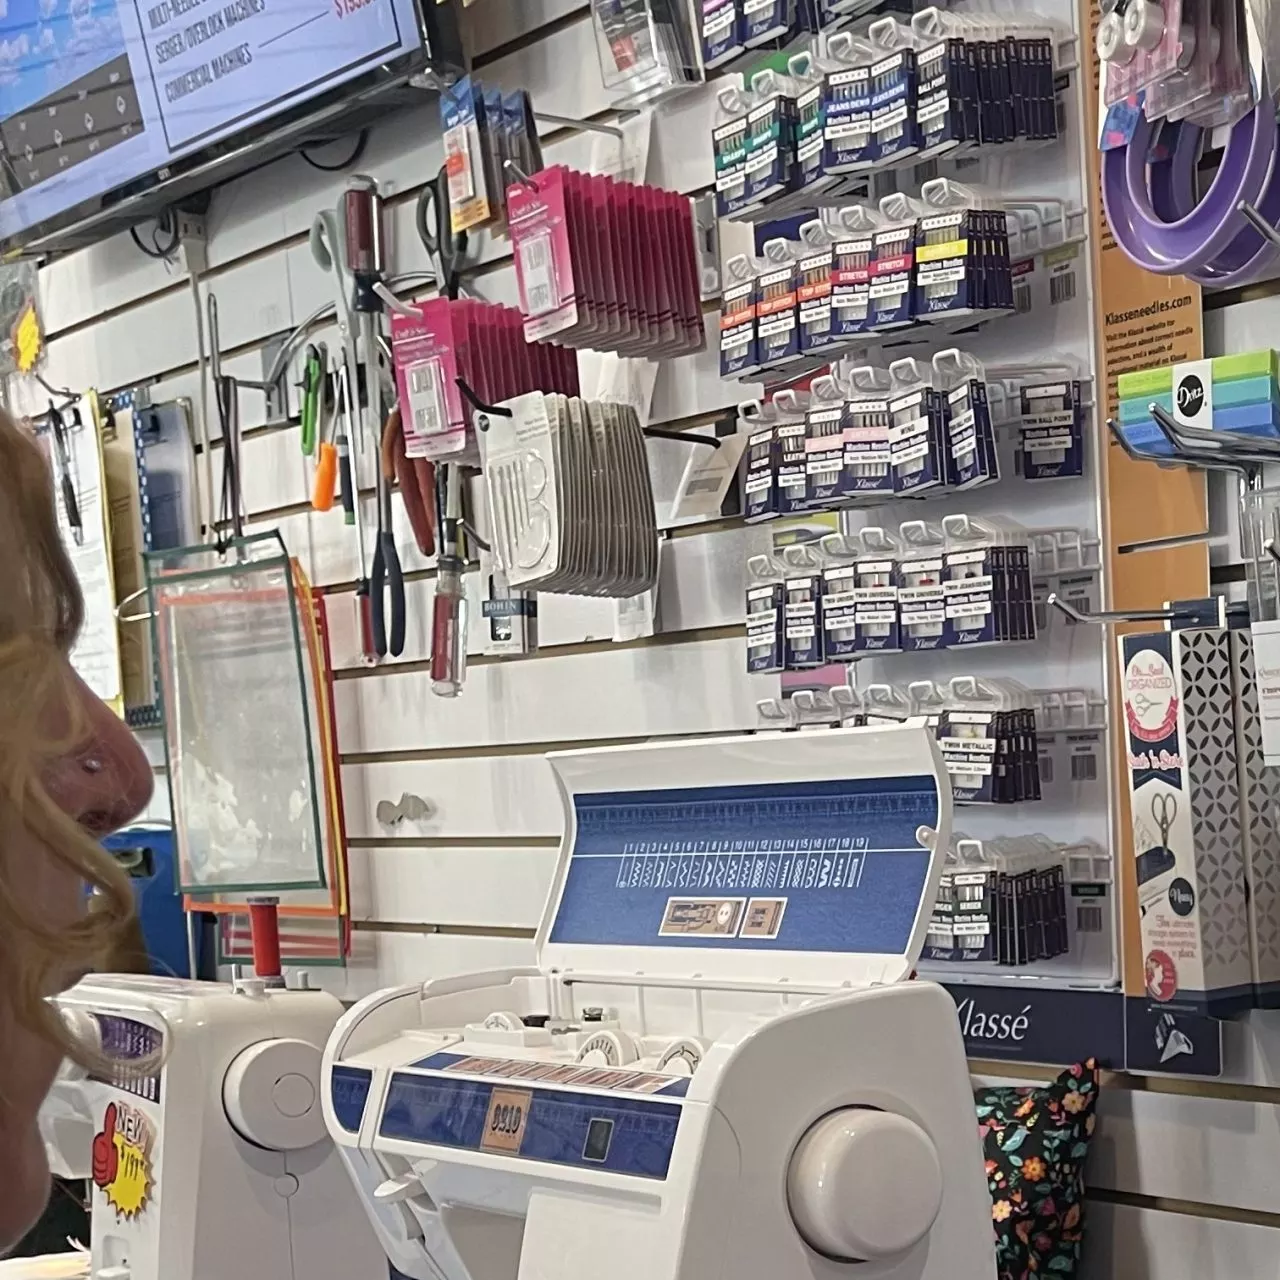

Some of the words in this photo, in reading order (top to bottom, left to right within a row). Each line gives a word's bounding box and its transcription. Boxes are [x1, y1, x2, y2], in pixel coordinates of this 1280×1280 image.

[211, 42, 252, 80] MACHINES
[876, 259, 905, 272] STRETCH
[839, 270, 868, 282] STRETCH
[1105, 294, 1192, 326] Klasseneedles.com
[1039, 415, 1053, 424] BALL
[944, 742, 960, 750] TWIN
[961, 741, 993, 750] METALLIC
[640, 843, 645, 851] 2
[652, 843, 657, 851] 3
[663, 843, 669, 851] 4
[686, 842, 692, 850] 6
[699, 842, 704, 850] 7
[711, 842, 717, 850] 8
[723, 841, 729, 849] 9
[735, 841, 743, 850] 10
[748, 841, 754, 849] 11
[760, 840, 768, 849] 12
[774, 840, 782, 849] 13
[787, 840, 795, 848] 14
[800, 839, 809, 848] 15
[828, 839, 836, 847] 17
[842, 838, 850, 847] 18
[856, 838, 865, 847] 19
[117, 1107, 145, 1144] NEW
